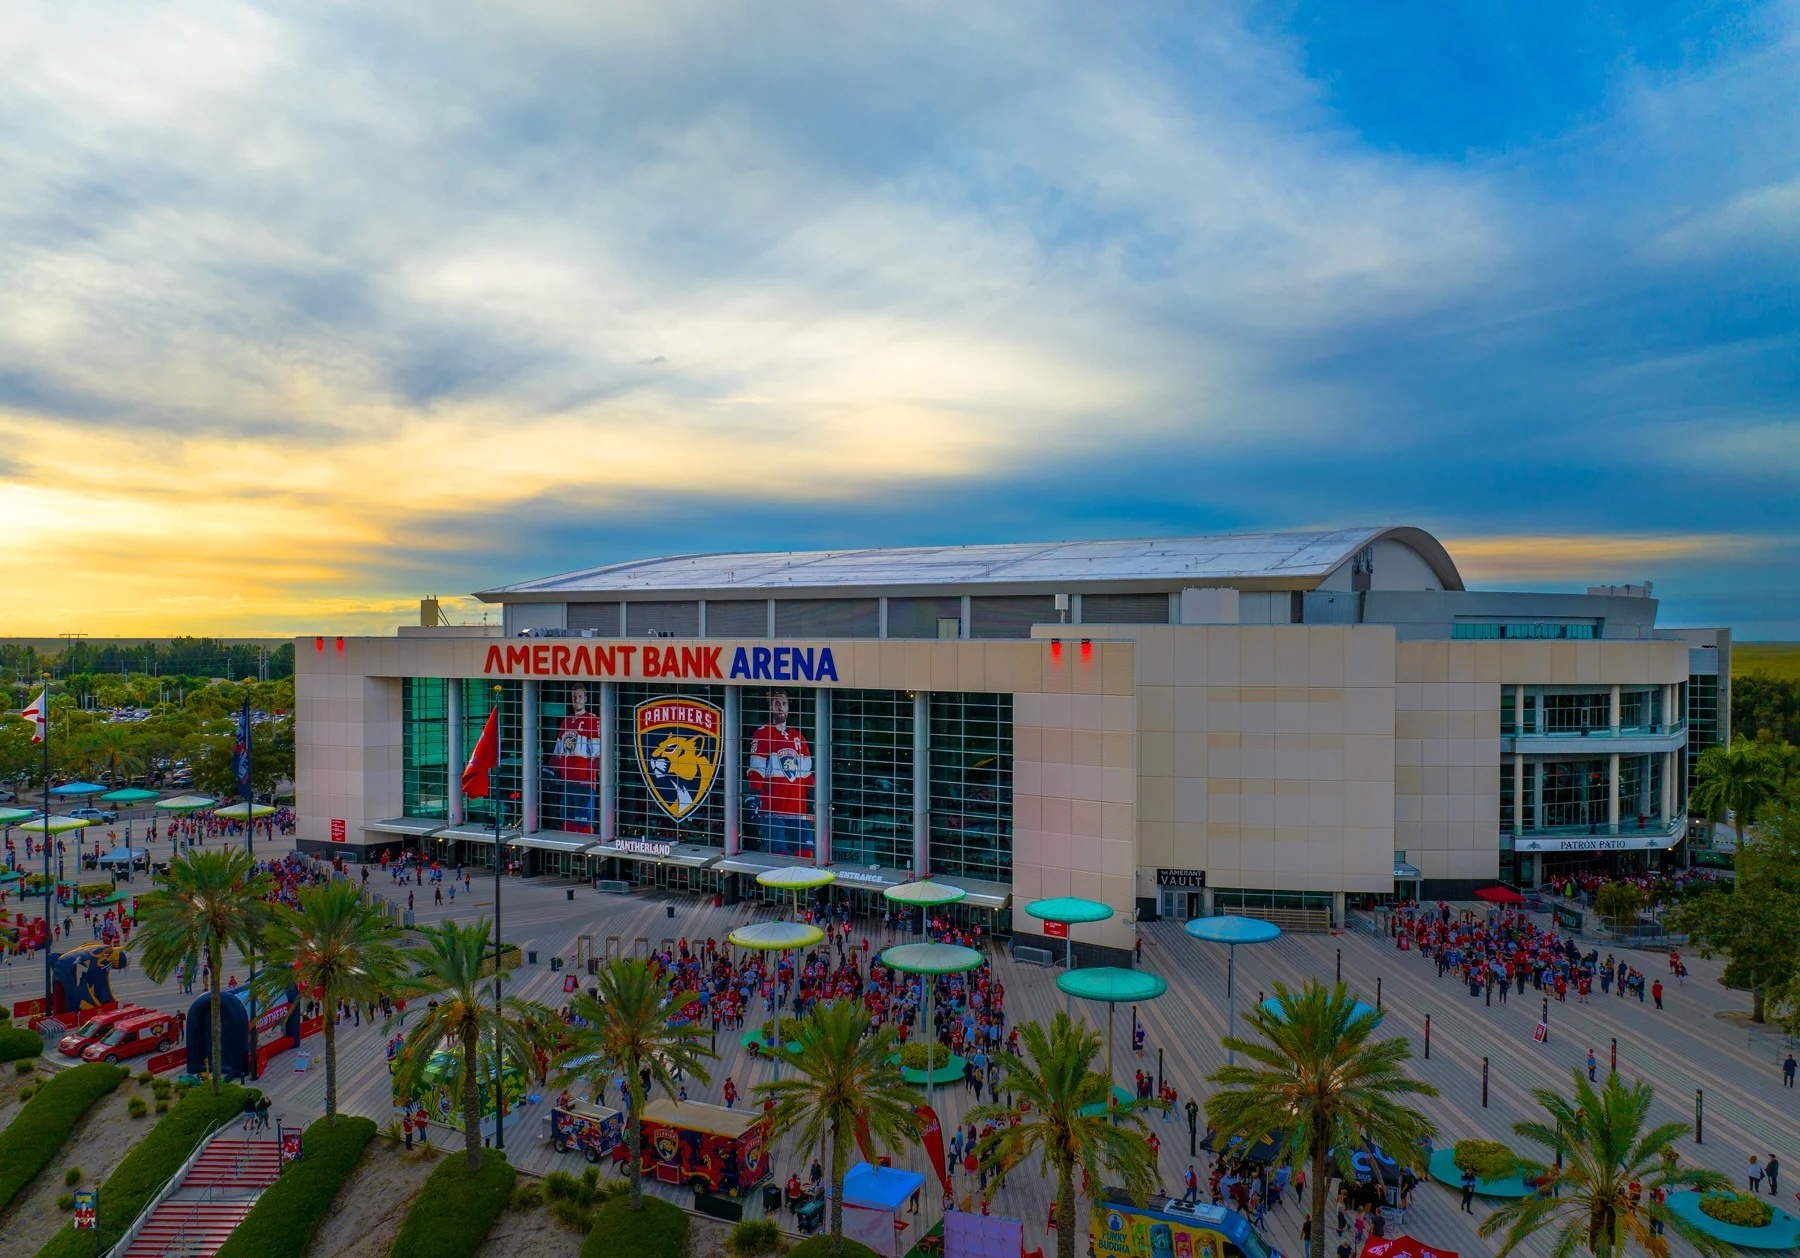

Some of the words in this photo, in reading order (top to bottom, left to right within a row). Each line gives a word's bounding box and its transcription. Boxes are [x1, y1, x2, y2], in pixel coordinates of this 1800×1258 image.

[484, 644, 637, 676] AMERANT
[643, 646, 723, 679] BANK
[730, 647, 839, 682] ARENA
[644, 706, 712, 729] PANTHERS
[615, 839, 671, 855] PANTHERLAND
[1560, 838, 1596, 850] PATRÓN
[1599, 840, 1626, 849] PATIO
[838, 870, 883, 883] ENTRANCE
[1169, 869, 1202, 877] AMERANT
[1160, 876, 1202, 887] VAULT
[1102, 1230, 1127, 1243] FUNKY
[1098, 1239, 1131, 1255] BUDDHA
